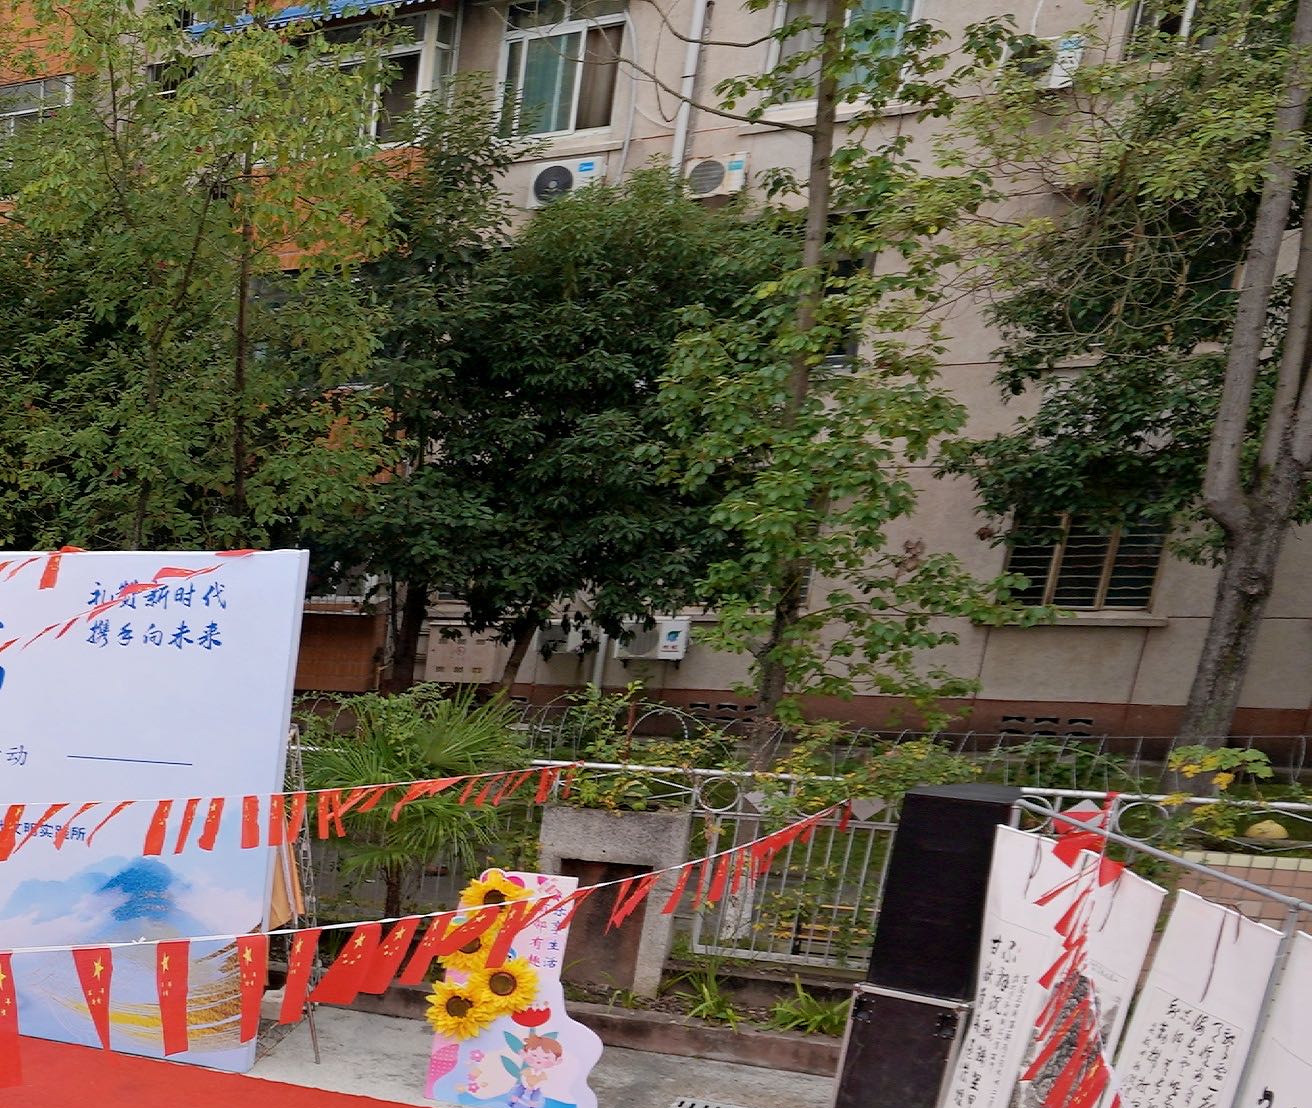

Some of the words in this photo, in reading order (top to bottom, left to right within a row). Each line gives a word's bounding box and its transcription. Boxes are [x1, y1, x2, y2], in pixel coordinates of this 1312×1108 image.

[85, 618, 224, 651] 携手向未来
